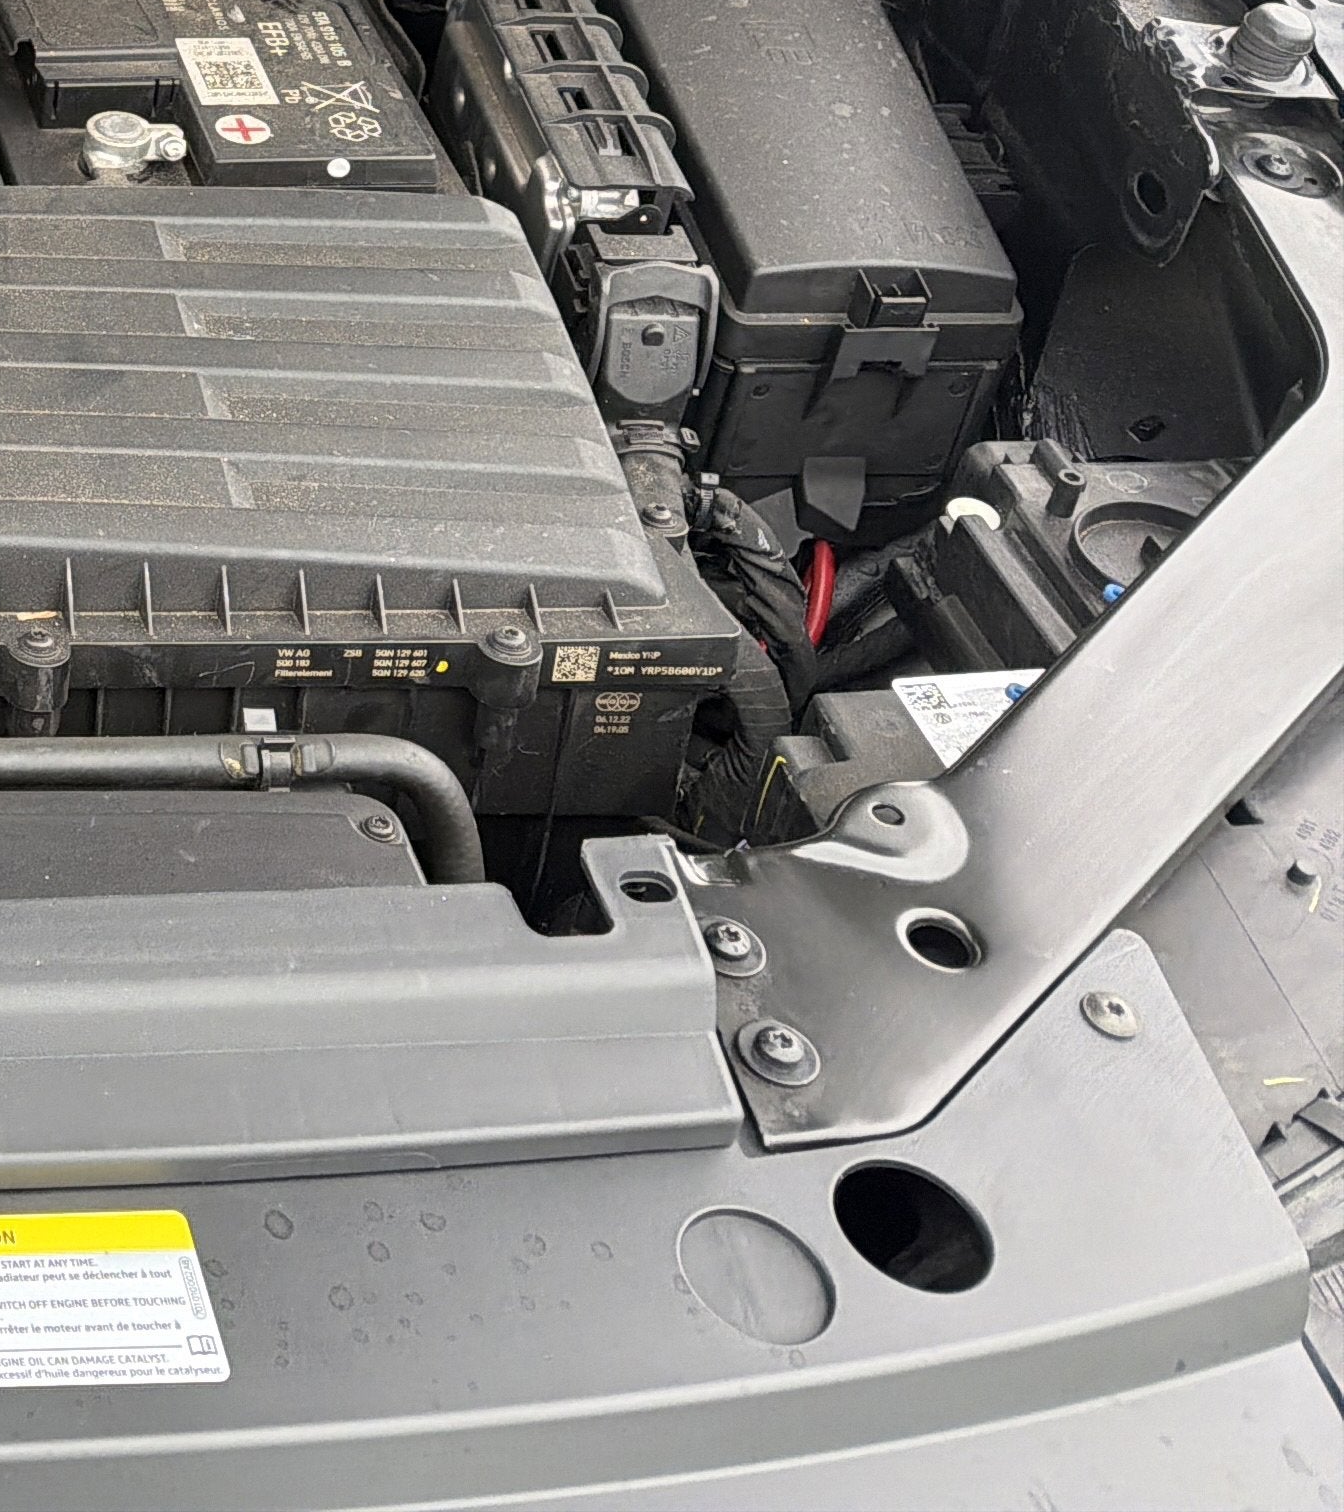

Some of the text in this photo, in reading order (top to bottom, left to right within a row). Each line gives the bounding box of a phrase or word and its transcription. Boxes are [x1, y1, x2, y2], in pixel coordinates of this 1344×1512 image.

[257, 22, 290, 57] EFB+
[281, 90, 302, 104] Pb
[277, 649, 310, 657] VW AG
[397, 649, 411, 657] 129
[413, 649, 428, 657] 601
[609, 651, 640, 660] Mexico
[395, 659, 410, 667] 129
[412, 659, 428, 667] 607
[393, 669, 408, 677] 129
[1, 1260, 31, 1269] START
[33, 1259, 46, 1269] AT
[48, 1259, 68, 1268] ANY
[42, 1273, 66, 1283] peut
[68, 1272, 80, 1280] se
[82, 1270, 138, 1280] déclencher
[149, 1270, 172, 1279] tout
[28, 1300, 48, 1309] OFF
[51, 1299, 89, 1308] ENGINE
[91, 1298, 131, 1307] BEFORE
[133, 1296, 186, 1306] TOUCHING
[31, 1324, 41, 1333] le
[44, 1324, 81, 1333] moteur
[85, 1323, 114, 1332] avant
[116, 1322, 130, 1331] de
[132, 1321, 172, 1331] toucher
[28, 1357, 45, 1367] OIL
[47, 1356, 69, 1366] CAN
[71, 1355, 115, 1365] DAMAGE
[72, 1369, 127, 1380] dangereux
[129, 1368, 153, 1378] pour
[155, 1367, 165, 1376] le
